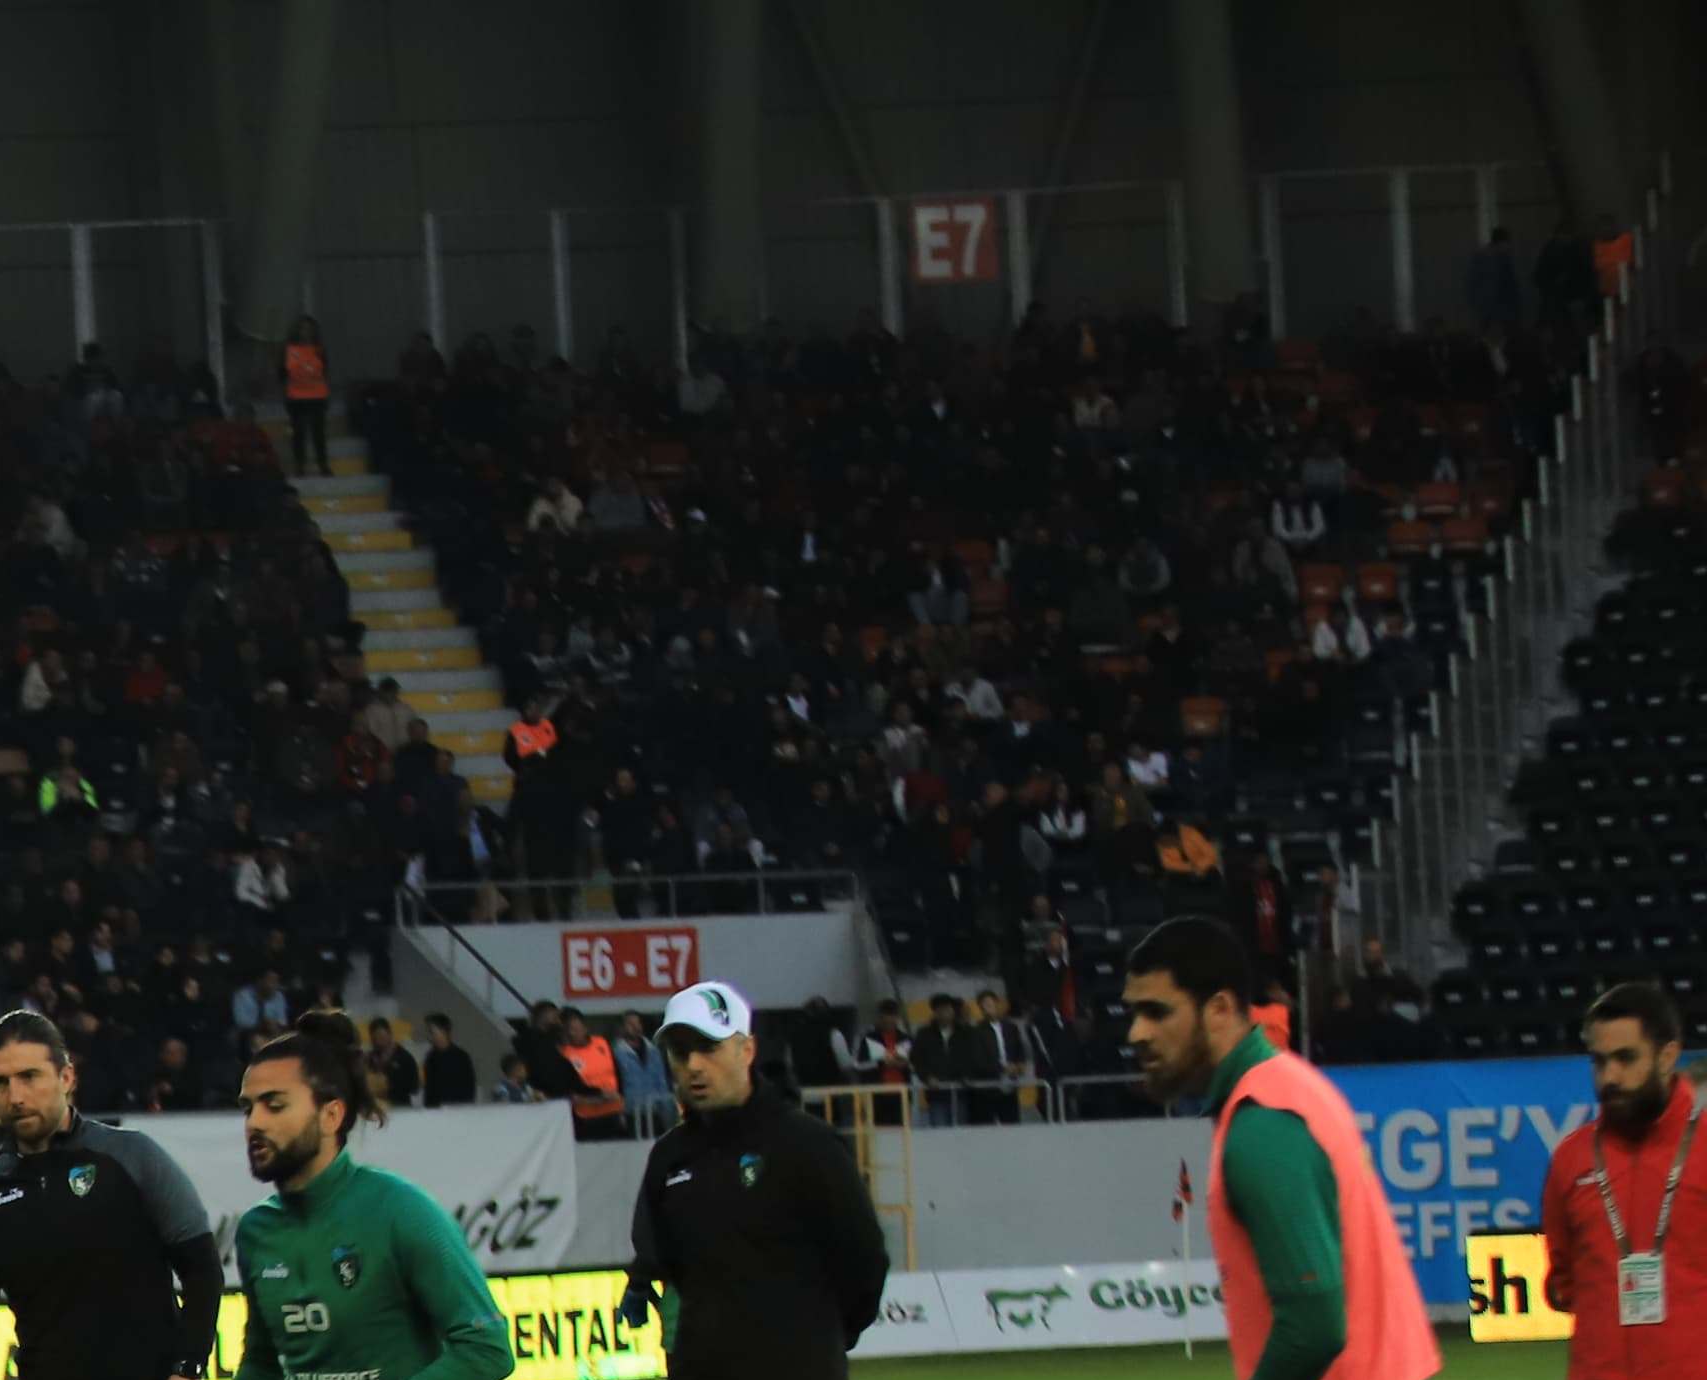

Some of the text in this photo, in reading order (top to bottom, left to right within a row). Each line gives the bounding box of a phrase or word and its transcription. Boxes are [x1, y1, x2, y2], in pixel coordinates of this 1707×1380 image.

[914, 203, 987, 279] E7
[568, 937, 615, 991] E6
[646, 933, 692, 988] E7
[281, 1302, 331, 1333] 20
[515, 1308, 630, 1359] ENTAL
